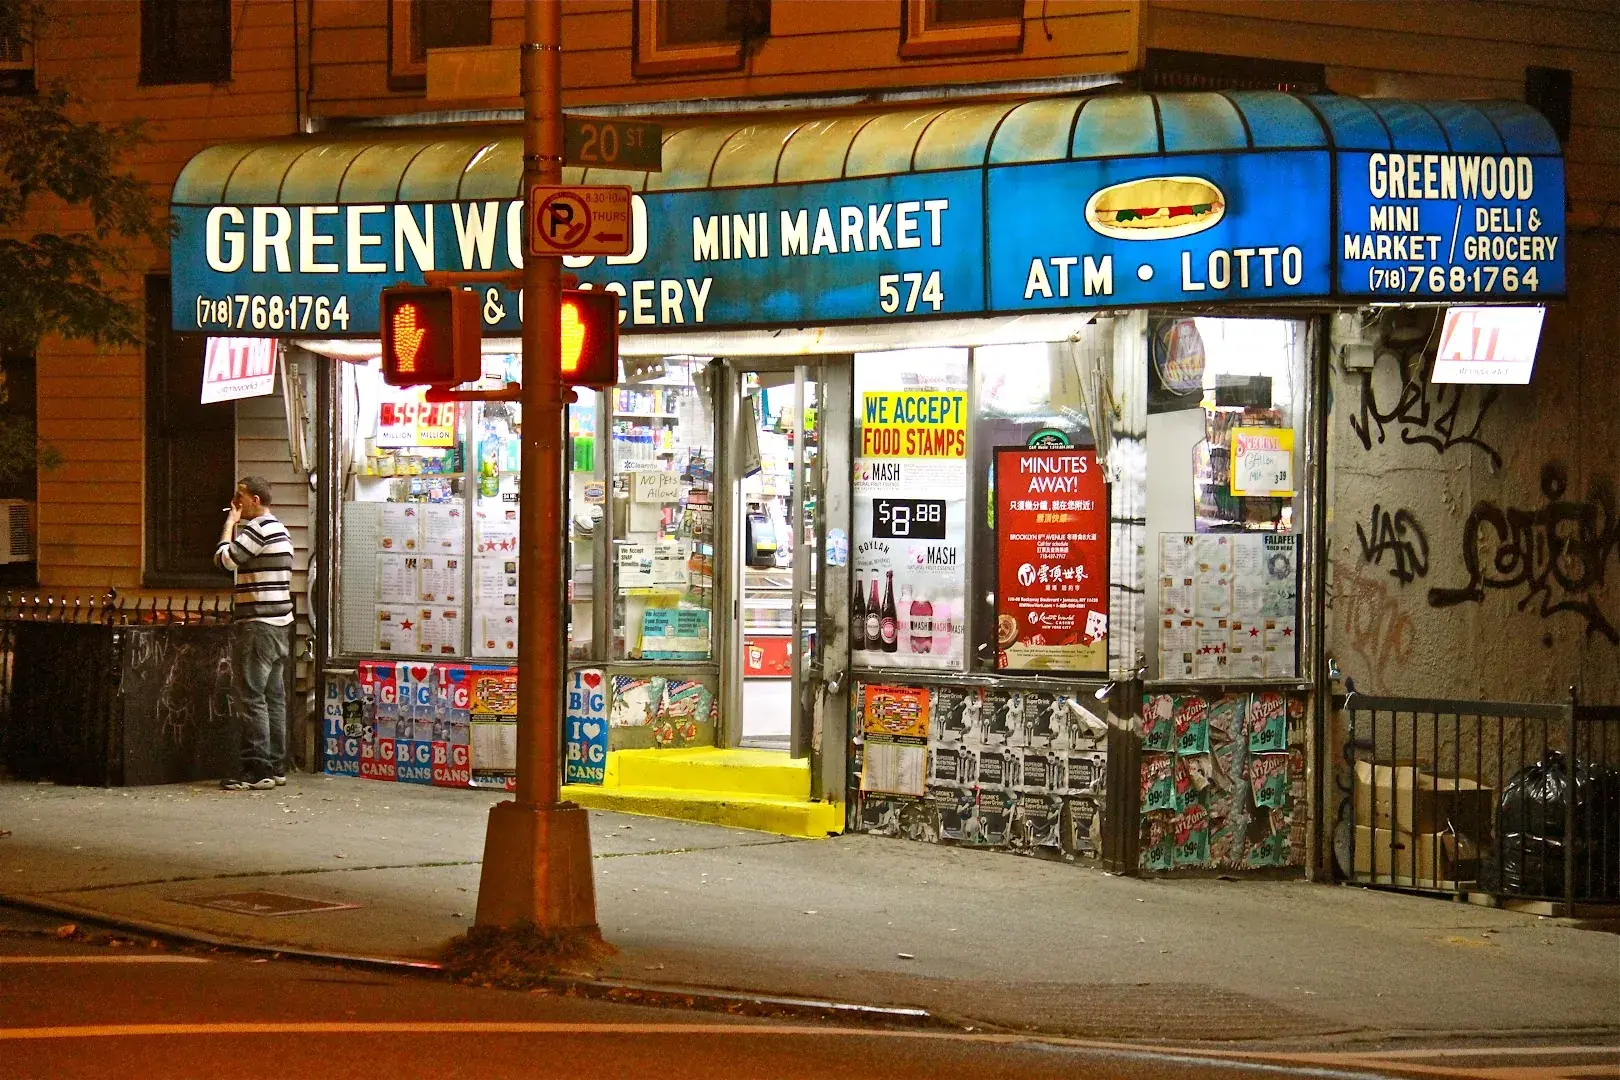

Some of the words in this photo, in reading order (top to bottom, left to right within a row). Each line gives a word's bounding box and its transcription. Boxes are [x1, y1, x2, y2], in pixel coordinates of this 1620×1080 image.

[580, 123, 620, 163] 20
[626, 128, 645, 147] ST
[1368, 152, 1535, 201] GREENWOOD
[592, 211, 627, 221] THURS
[1369, 206, 1420, 232] MINI
[1475, 207, 1524, 233] DELI
[1527, 207, 1544, 233] &
[691, 211, 769, 262] MINI
[780, 198, 950, 257] MARKET
[1343, 234, 1441, 262] MARKET
[1463, 235, 1559, 262] GROCERY
[1024, 255, 1115, 300] ATM
[1181, 246, 1304, 291] LOTTO
[878, 270, 945, 314] 574
[483, 287, 506, 325] &
[207, 336, 277, 383] ATM
[865, 395, 888, 424] WE
[893, 395, 963, 424] ACCEPT
[420, 431, 450, 439] MILLION
[863, 428, 900, 456] FOOD
[906, 428, 966, 457] STAMPS
[1236, 433, 1281, 457] SPECIAL
[872, 463, 900, 481] MASH
[1020, 456, 1088, 474] MINUTES
[640, 475, 656, 486] NO
[1028, 476, 1078, 493] AWAY!
[858, 541, 890, 555] BOYLAN
[1264, 535, 1295, 545] FALAFEL
[927, 546, 957, 565] MASH
[913, 621, 928, 631] MASH
[932, 622, 946, 631] MASH
[402, 665, 410, 683] I
[438, 667, 447, 685] I
[574, 672, 582, 689] I
[1250, 698, 1284, 724] AriZona
[572, 722, 580, 740] I
[327, 760, 360, 773] CANS
[362, 763, 395, 777] CANS
[398, 766, 431, 780] CANS
[434, 768, 469, 782] CANS
[568, 764, 604, 780] CANS
